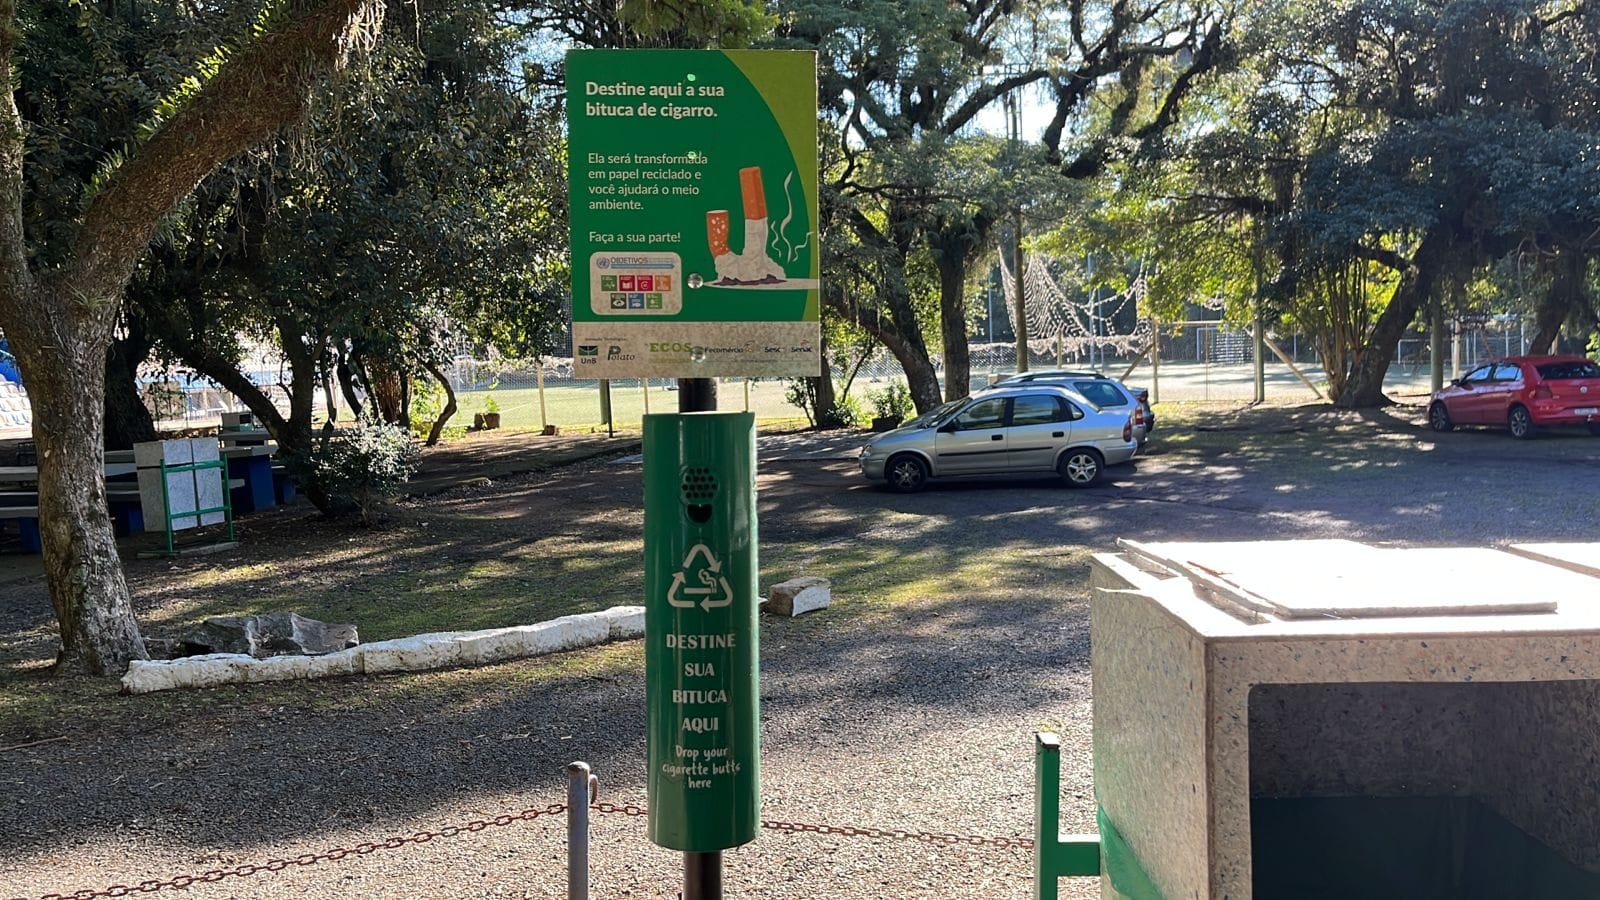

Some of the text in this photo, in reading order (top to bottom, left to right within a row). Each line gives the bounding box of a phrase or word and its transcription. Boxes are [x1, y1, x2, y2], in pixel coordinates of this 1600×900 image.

[585, 81, 725, 99] Destine aqui a sua
[585, 102, 718, 119] bituca de cigarro.
[588, 151, 708, 164] Ela será transformada
[588, 169, 702, 181] em papel reciclado e
[588, 184, 615, 194] você
[618, 184, 659, 197] ajudará
[672, 184, 700, 195] meio
[589, 199, 644, 210] ambiente.
[589, 231, 681, 245] Faça a sua parte!
[666, 633, 736, 649] DESTINE
[684, 663, 715, 677] SUA
[672, 690, 727, 704] BITUCA
[681, 717, 719, 733] AQUI
[675, 744, 729, 762] Drop your
[662, 761, 741, 777] cigarette butts
[688, 777, 712, 789] here
